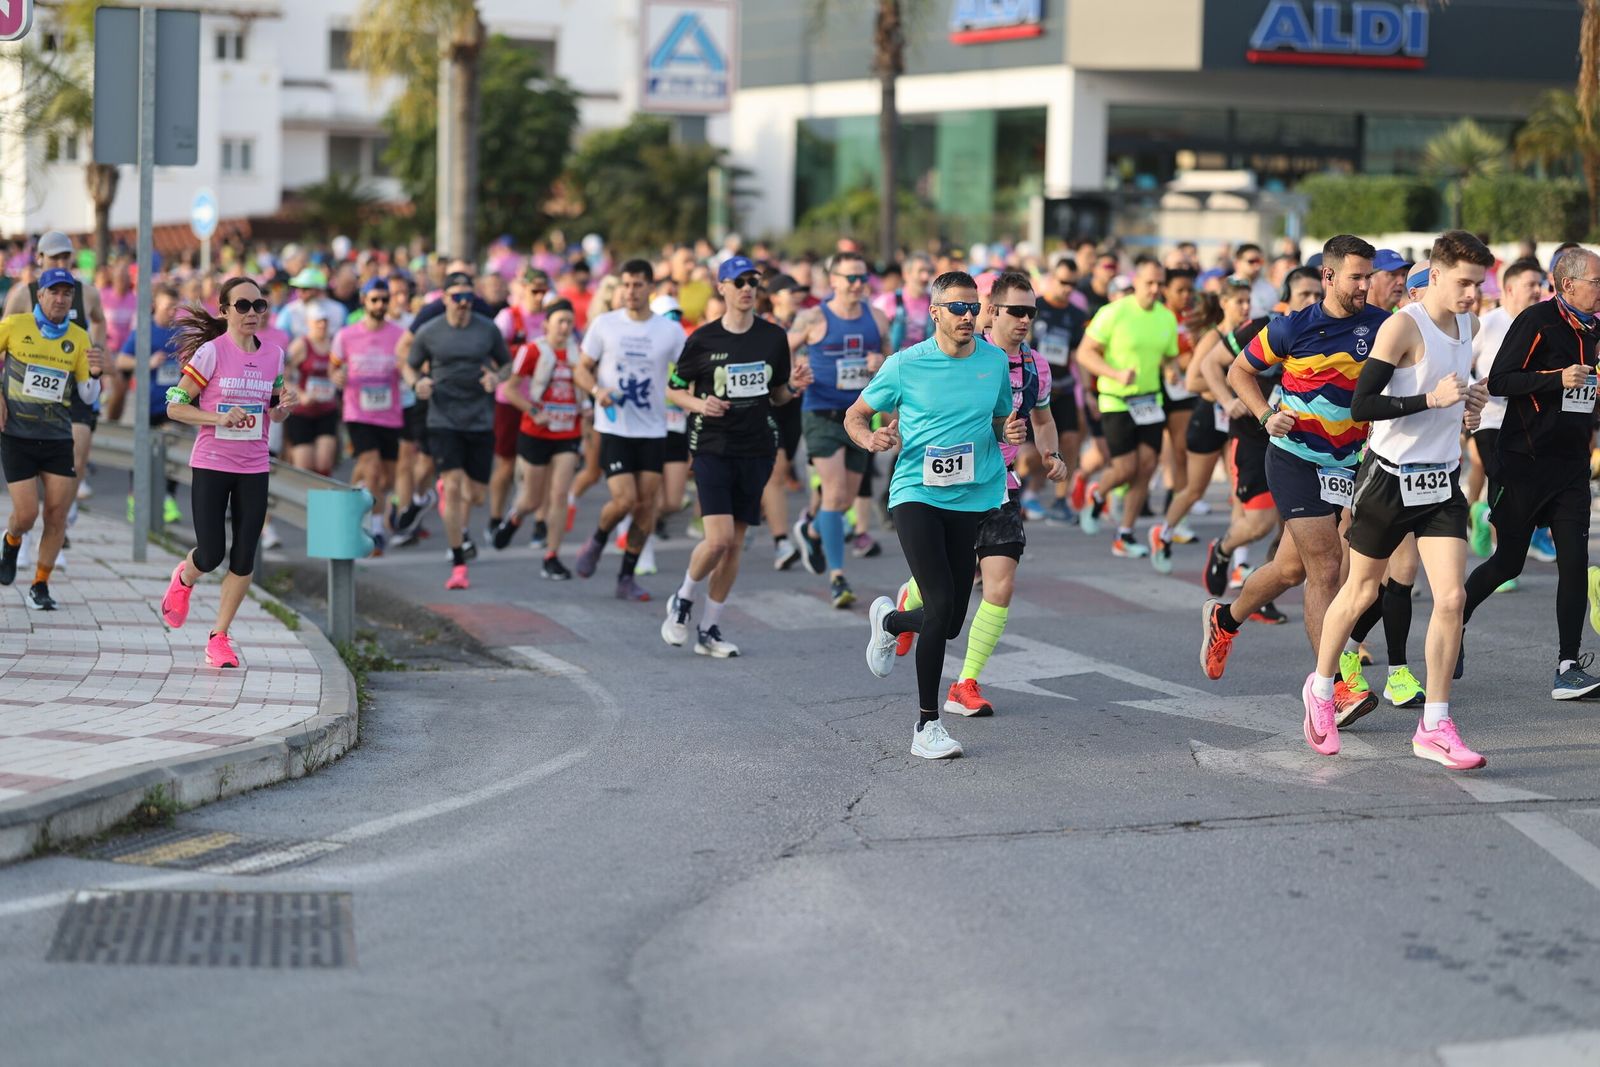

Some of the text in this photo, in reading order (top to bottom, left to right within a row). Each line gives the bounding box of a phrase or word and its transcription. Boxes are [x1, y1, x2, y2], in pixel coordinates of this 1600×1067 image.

[1249, 0, 1429, 56] ALDI
[32, 375, 60, 390] 282
[219, 377, 245, 389] MEDIA
[730, 372, 766, 387] 1823
[1564, 386, 1597, 401] 2112
[931, 455, 963, 474] 631
[1321, 475, 1353, 496] 1693
[1404, 471, 1449, 492] 1432
